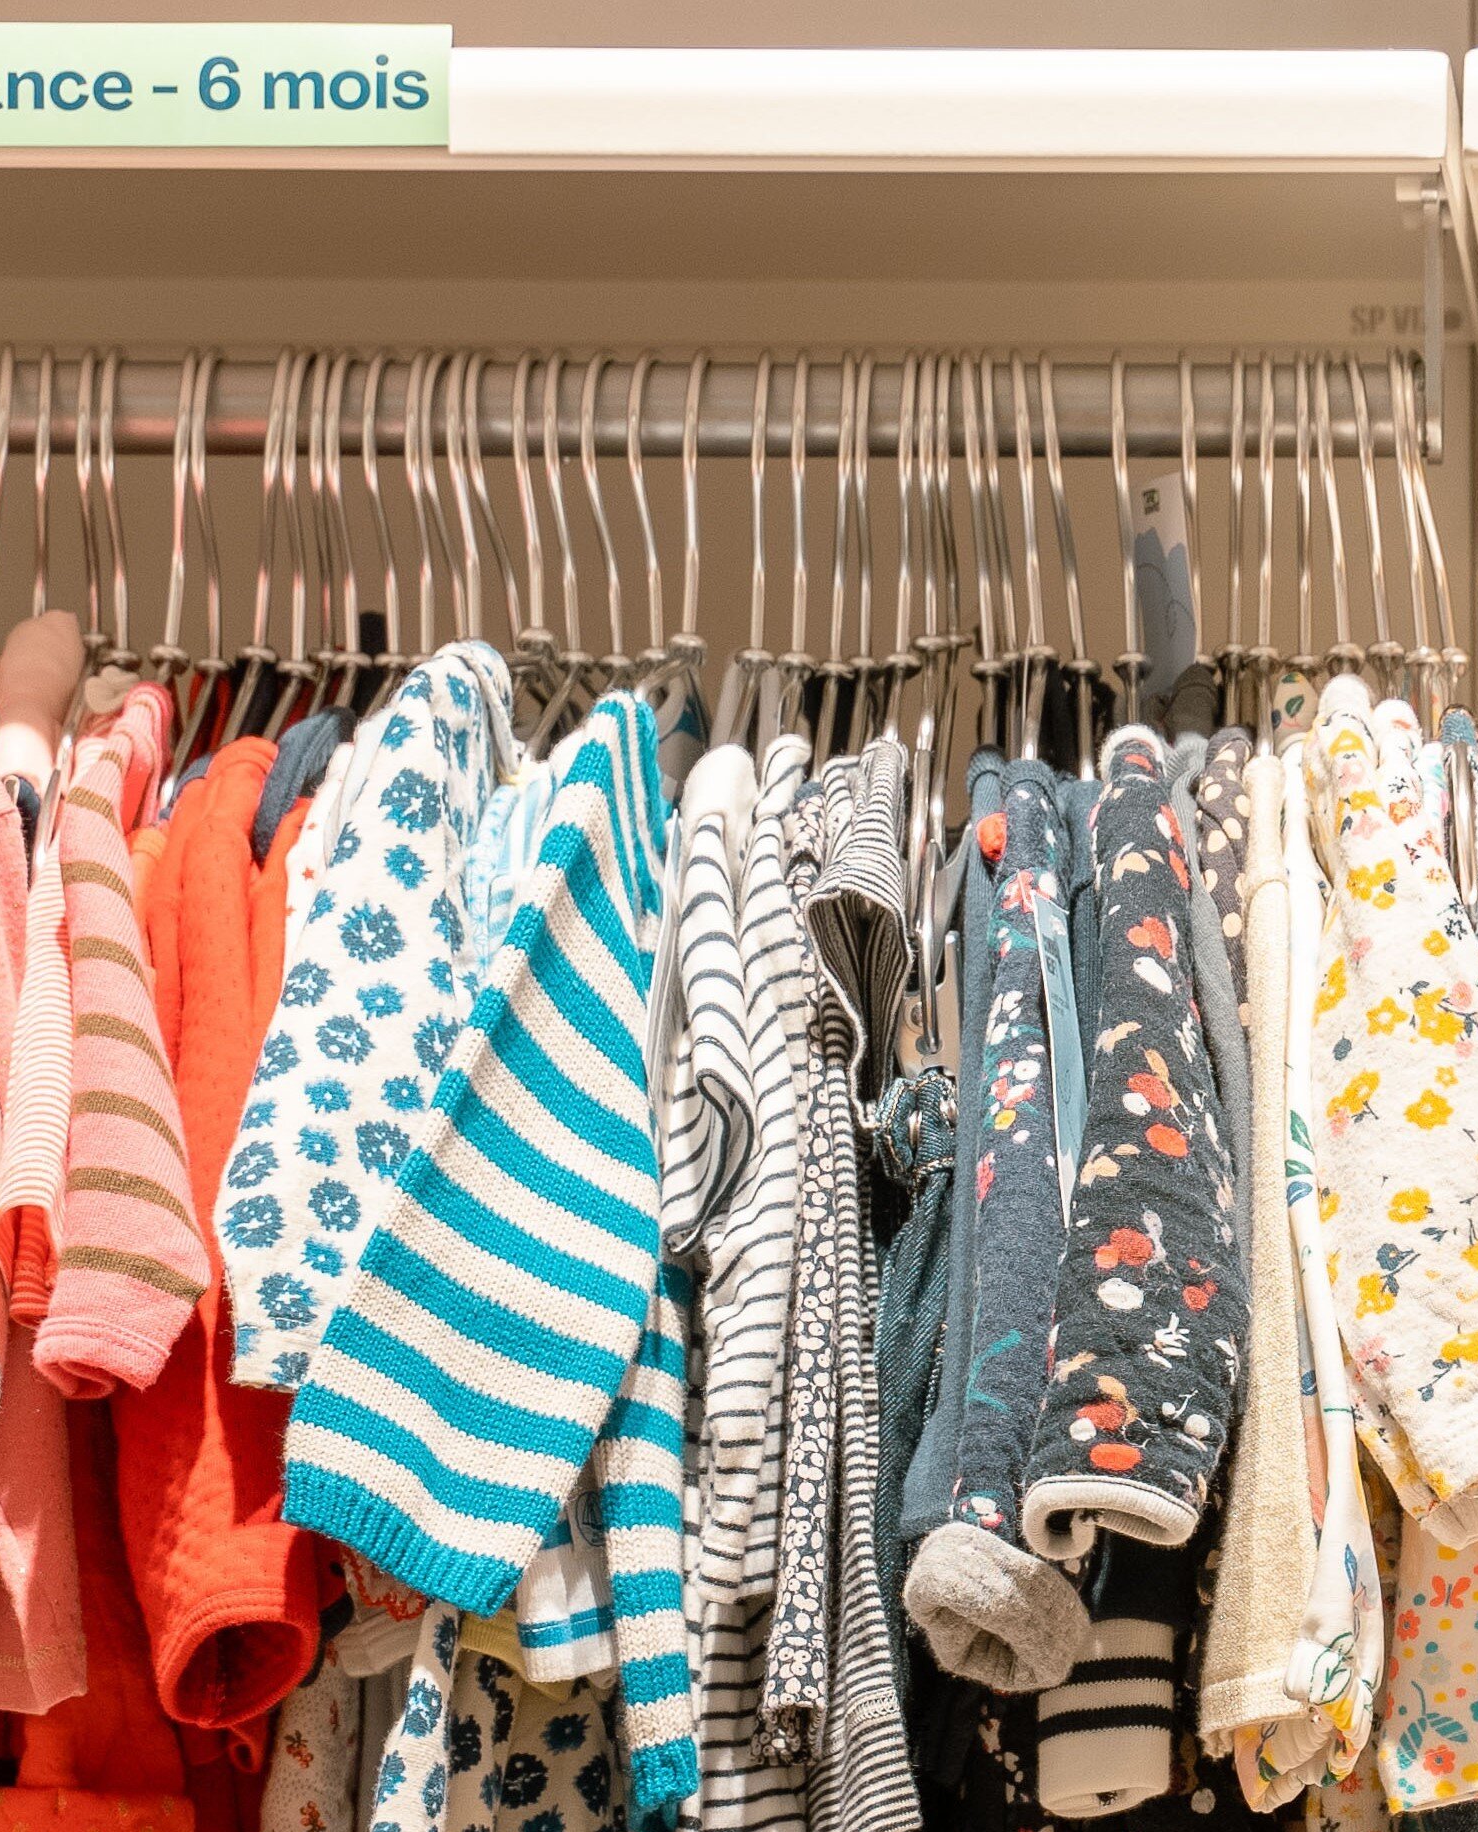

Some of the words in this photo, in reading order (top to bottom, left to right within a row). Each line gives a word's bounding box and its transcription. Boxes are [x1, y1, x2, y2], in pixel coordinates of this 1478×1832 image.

[152, 85, 179, 94] -
[198, 55, 242, 112] 6
[263, 54, 430, 111] mois
